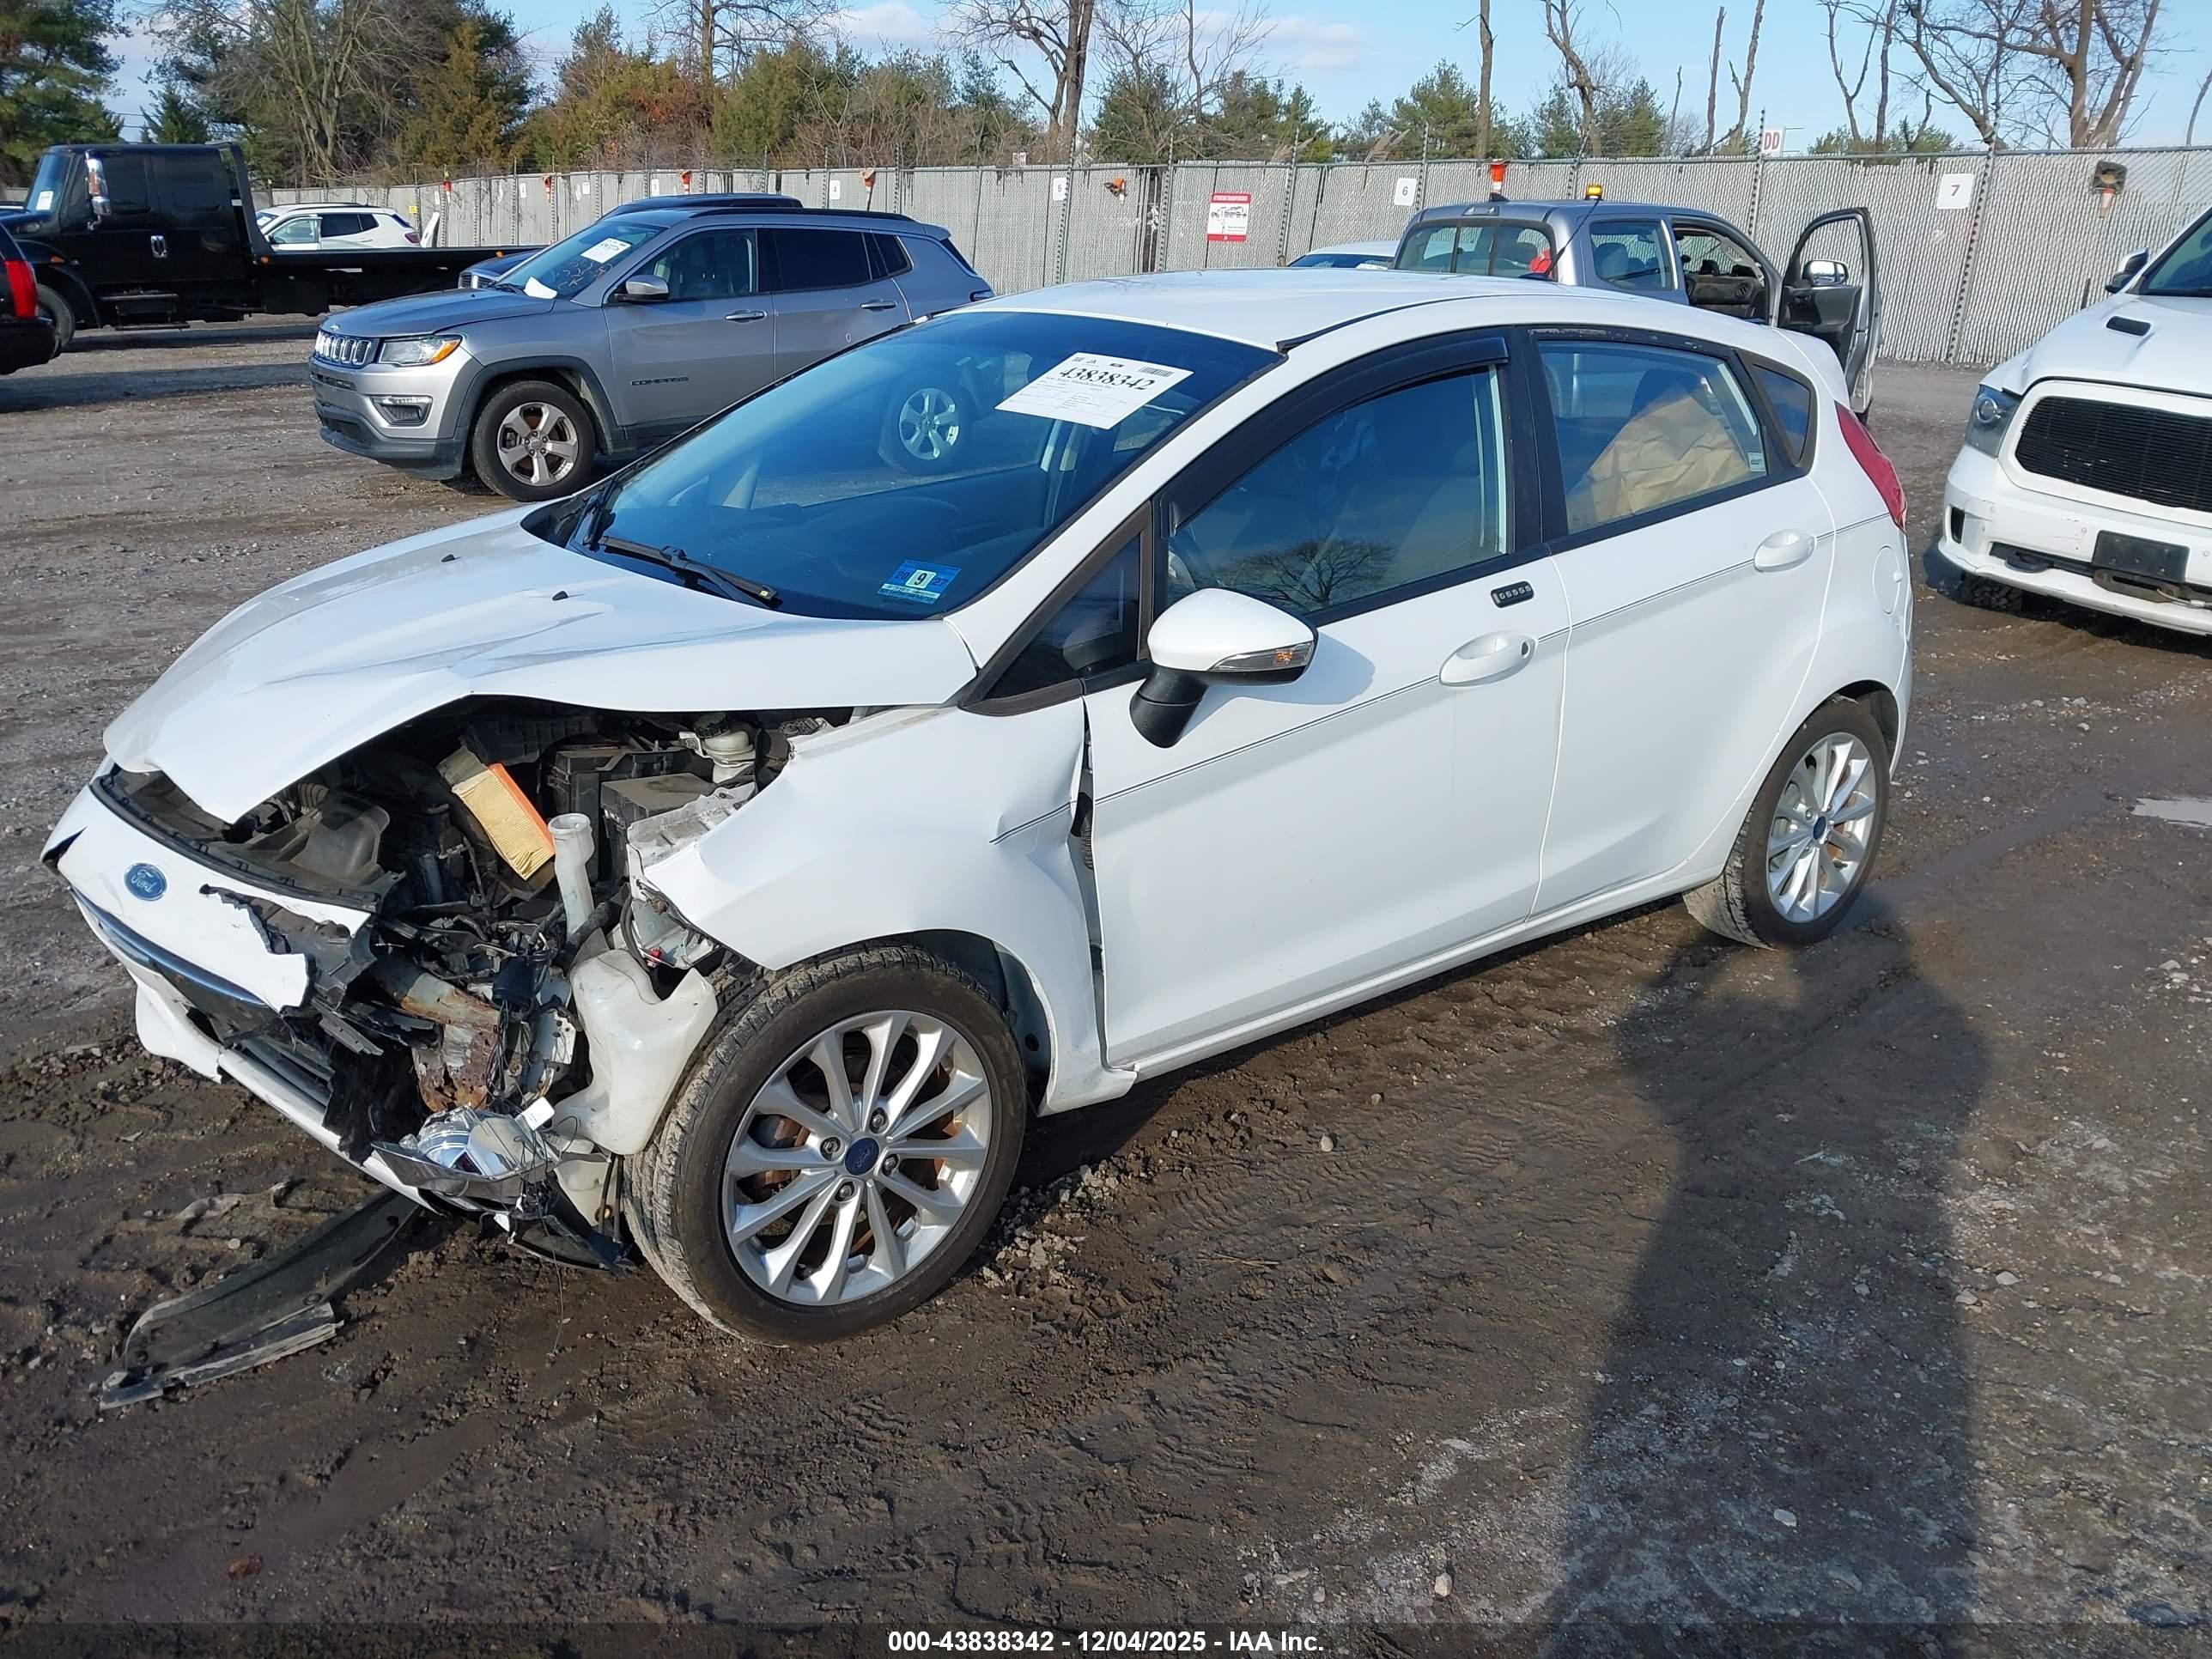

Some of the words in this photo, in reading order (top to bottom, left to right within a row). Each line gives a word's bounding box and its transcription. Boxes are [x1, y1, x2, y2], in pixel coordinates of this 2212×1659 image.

[1764, 131, 1780, 150] DD
[1402, 185, 1409, 197] 6
[1951, 184, 1960, 197] 7
[1060, 367, 1156, 390] 43838342
[914, 572, 927, 586] 9
[131, 868, 158, 893] Ford
